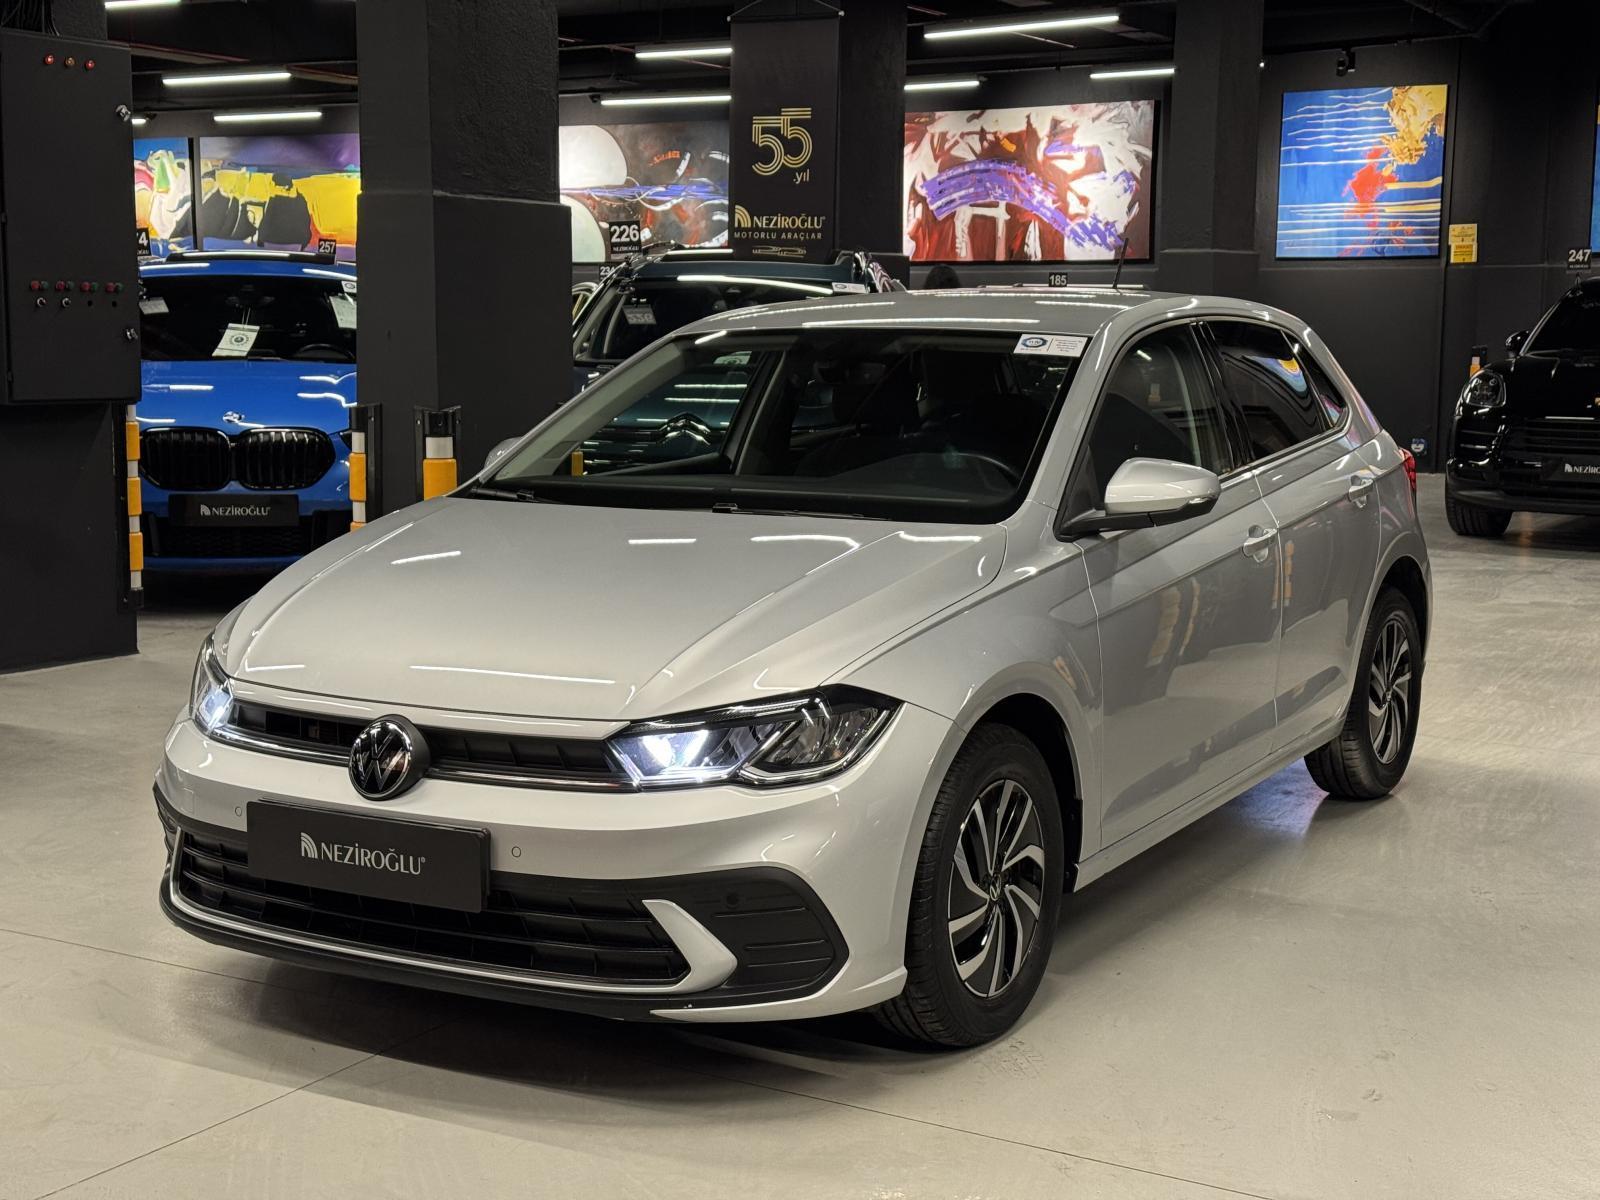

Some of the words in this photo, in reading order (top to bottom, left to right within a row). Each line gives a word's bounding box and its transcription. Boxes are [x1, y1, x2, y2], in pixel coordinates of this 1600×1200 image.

[752, 107, 813, 176] 55
[753, 213, 823, 229] NEZİROĞLU
[610, 224, 640, 243] 226
[734, 231, 777, 239] MOTORLU
[781, 232, 822, 241] ARAÇLAR
[319, 241, 336, 253] 257
[1568, 249, 1592, 262] 247
[1049, 274, 1067, 286] 185
[212, 504, 269, 516] NEZİROĞLU
[321, 842, 421, 875] NEZİROĞLU
